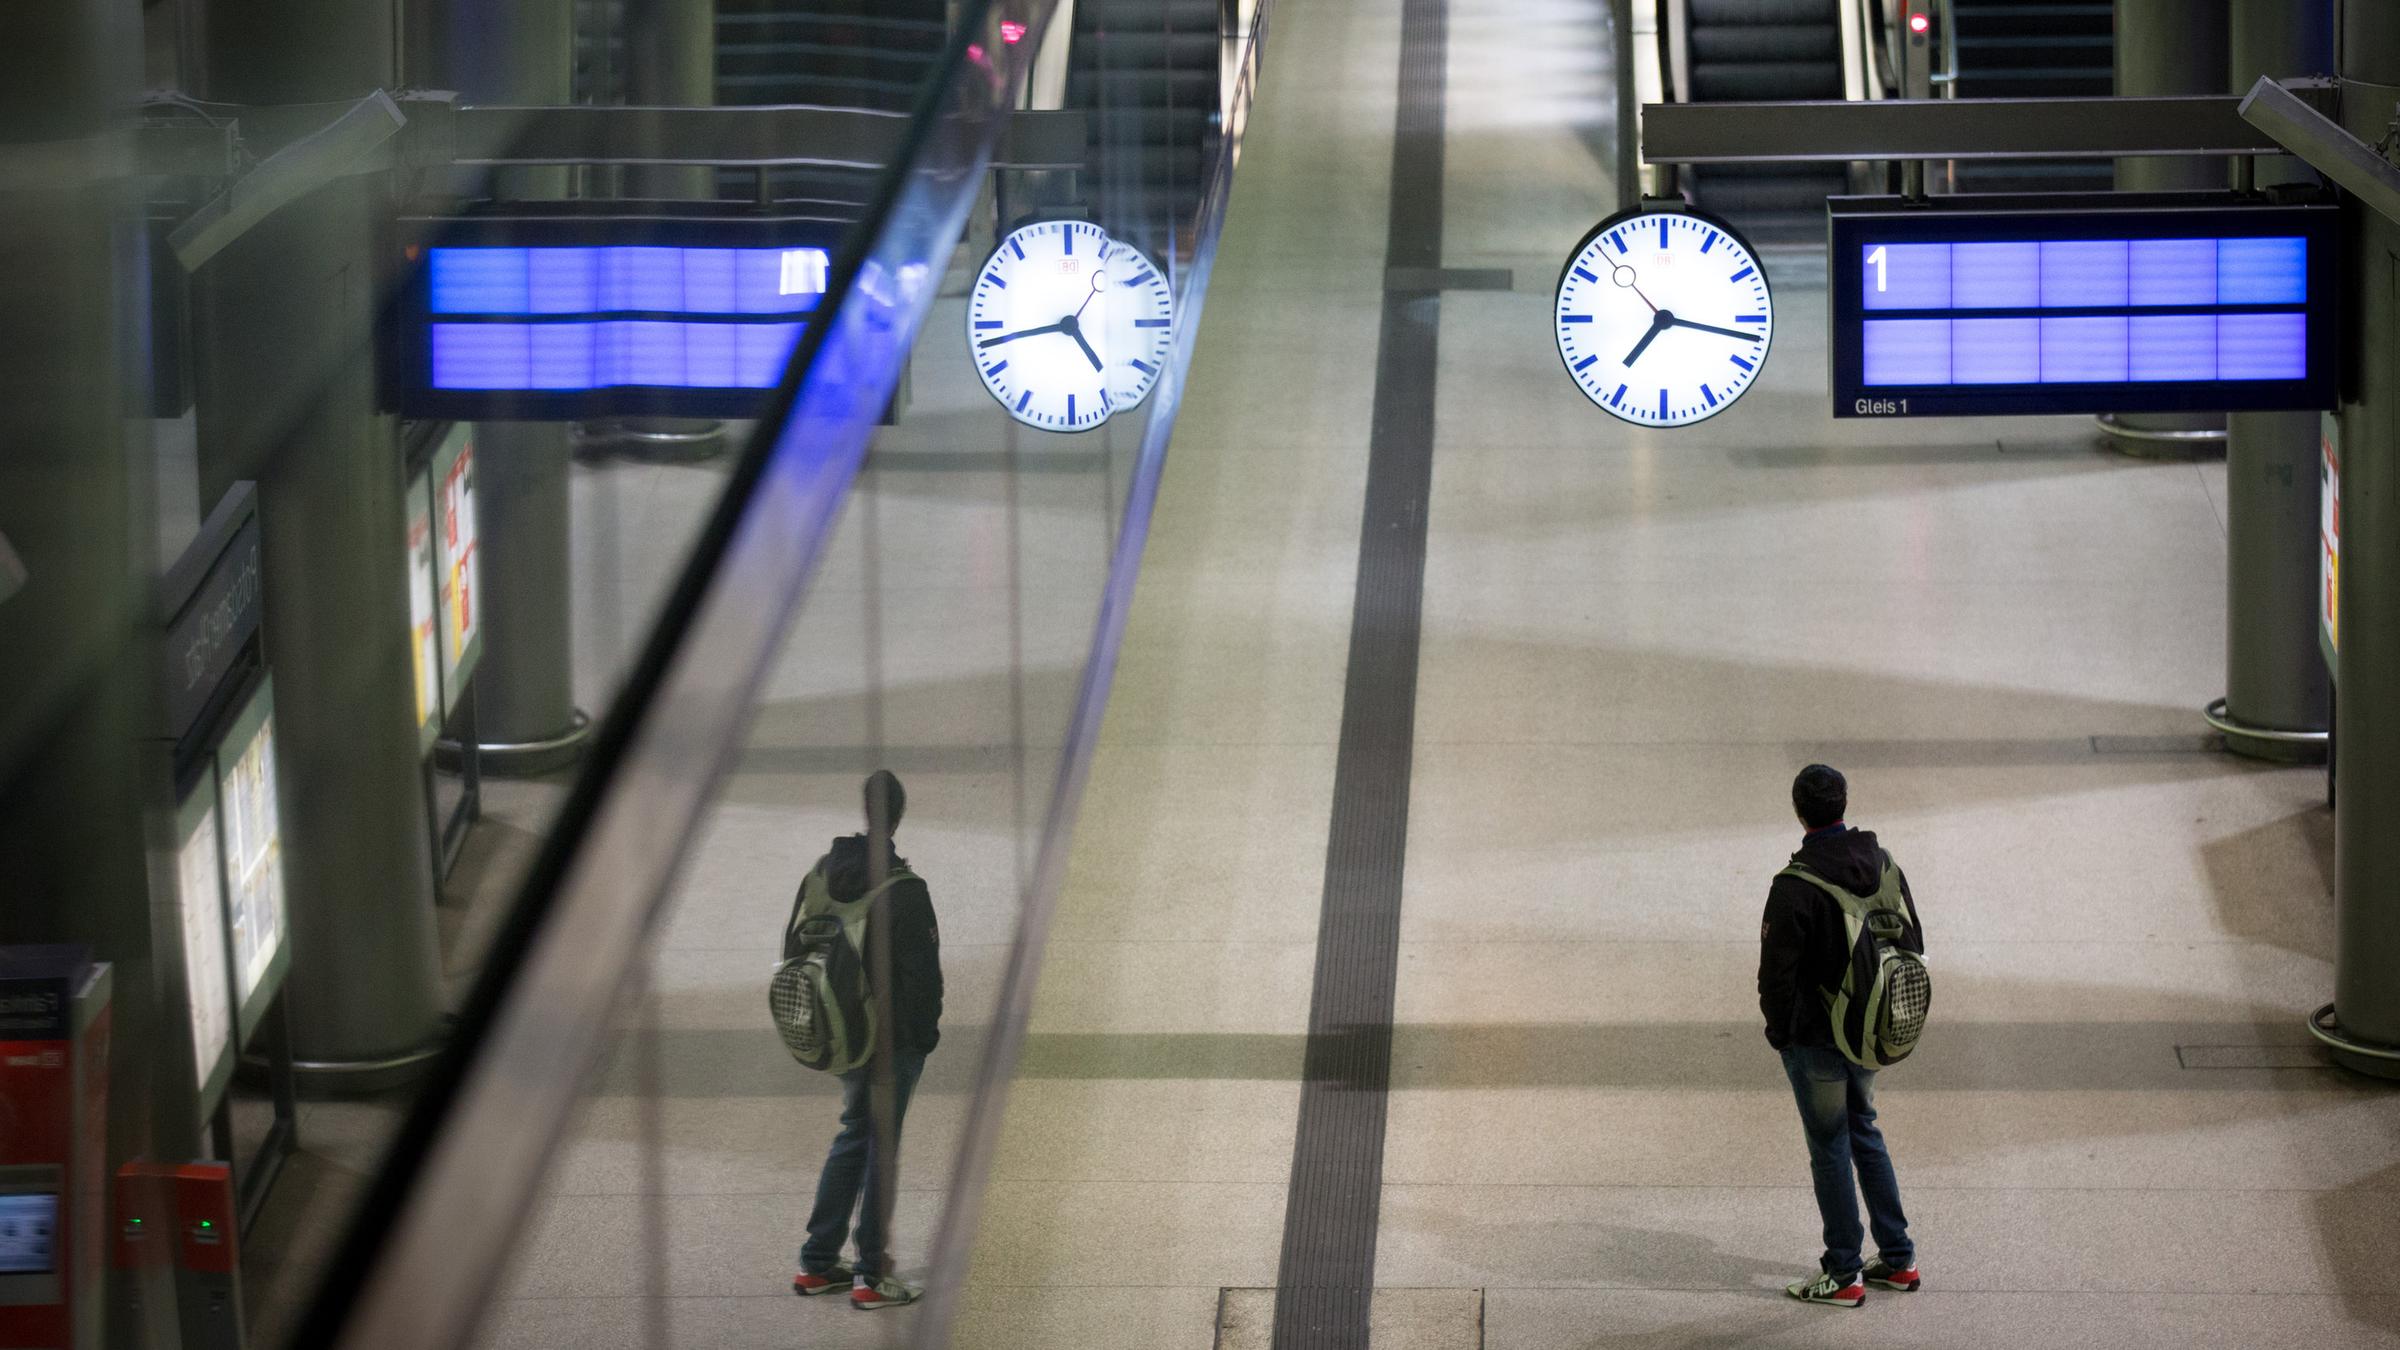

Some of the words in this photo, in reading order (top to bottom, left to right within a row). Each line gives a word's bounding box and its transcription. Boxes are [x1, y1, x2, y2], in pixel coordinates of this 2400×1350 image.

[1867, 246, 1886, 292] 1
[1855, 398, 1897, 414] Gleis
[1900, 398, 1907, 414] 1
[1809, 1279, 1839, 1297] FILA
